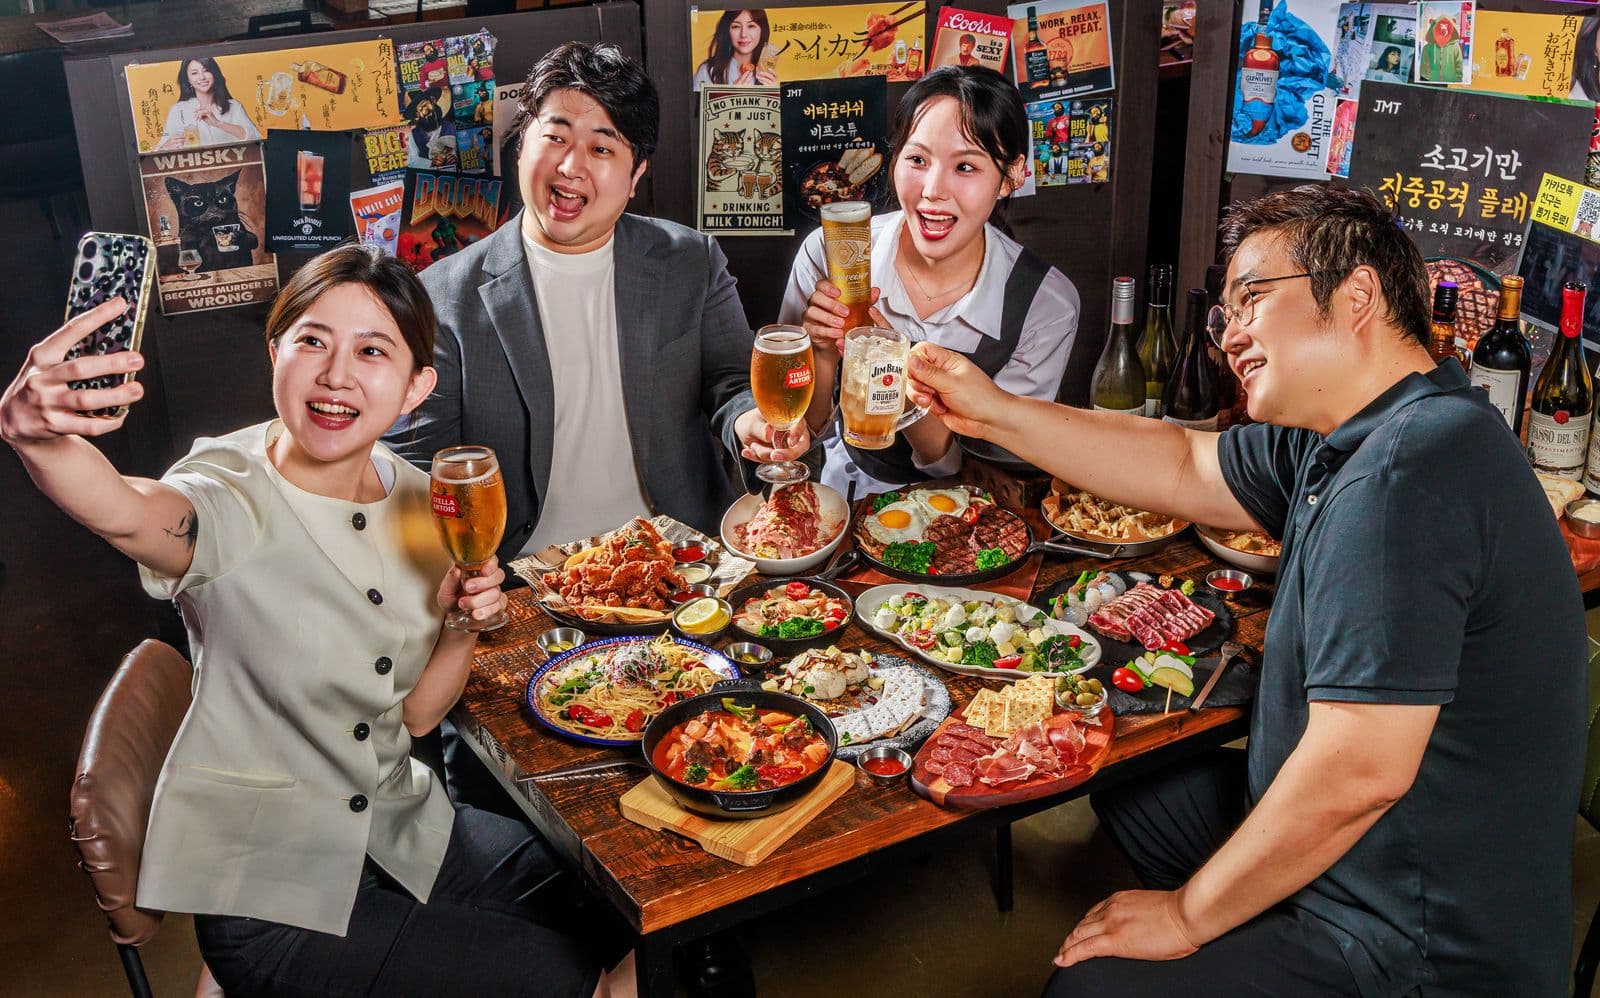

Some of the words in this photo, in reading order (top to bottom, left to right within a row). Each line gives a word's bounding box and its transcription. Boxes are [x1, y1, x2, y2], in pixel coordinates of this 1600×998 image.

[949, 13, 992, 34] Coors
[1040, 17, 1068, 31] WORK.
[1071, 11, 1101, 24] RELAX.
[1059, 21, 1102, 38] REPEAT.
[976, 44, 1003, 56] SEXY
[980, 54, 1001, 62] man!
[378, 42, 394, 96] 角ハイボール
[400, 62, 419, 75] BIG
[402, 74, 421, 84] PEAT
[787, 89, 803, 98] JMT
[713, 100, 726, 111] NO
[730, 96, 760, 107] THANK
[766, 99, 781, 110] YO
[803, 100, 864, 120] 버터굴라쉬
[1373, 99, 1402, 114] JMT
[747, 111, 772, 120] JUST
[810, 122, 858, 140] 비프스튜
[1032, 120, 1044, 132] IG
[1070, 119, 1086, 130] BIG
[1307, 94, 1325, 160] GLENLIVET
[1322, 119, 1332, 138] THE
[1032, 130, 1046, 140] EAT
[1070, 128, 1087, 137] PEAT
[364, 131, 400, 158] BIG
[153, 146, 248, 170] WHISKY
[460, 150, 478, 160] BIG
[1420, 144, 1523, 181] 소고기만
[368, 152, 408, 175] PEAT
[460, 159, 480, 170] PEAT
[1068, 159, 1084, 170] BIG
[1068, 168, 1084, 177] PEAT
[1544, 178, 1574, 196] 카카오톡
[409, 172, 504, 231] DOOM
[1378, 172, 1470, 218] 집중공격
[1478, 188, 1536, 224] 플래
[1540, 192, 1562, 208] 친구는
[722, 203, 770, 212] DRINKING
[293, 218, 304, 228] JACK
[706, 216, 732, 228] MILK
[738, 215, 784, 227] TONIGHT
[1536, 206, 1551, 220] 뽑기
[1552, 211, 1570, 228] 무료!
[1399, 216, 1425, 232] 가득
[1429, 222, 1449, 235] 오직
[1454, 226, 1497, 242] 고기에만
[1502, 232, 1523, 246] 집중
[164, 289, 214, 302] BECAUSE
[216, 282, 259, 295] MURDER
[264, 279, 274, 290] IS
[188, 290, 254, 310] WRONG
[788, 369, 810, 378] STELLA
[872, 366, 886, 378] JIM
[886, 364, 903, 376] BEAM
[872, 392, 899, 401] BOURBON
[1532, 425, 1555, 444] PASSO
[1557, 433, 1572, 444] DEL
[432, 496, 455, 506] STELLA
